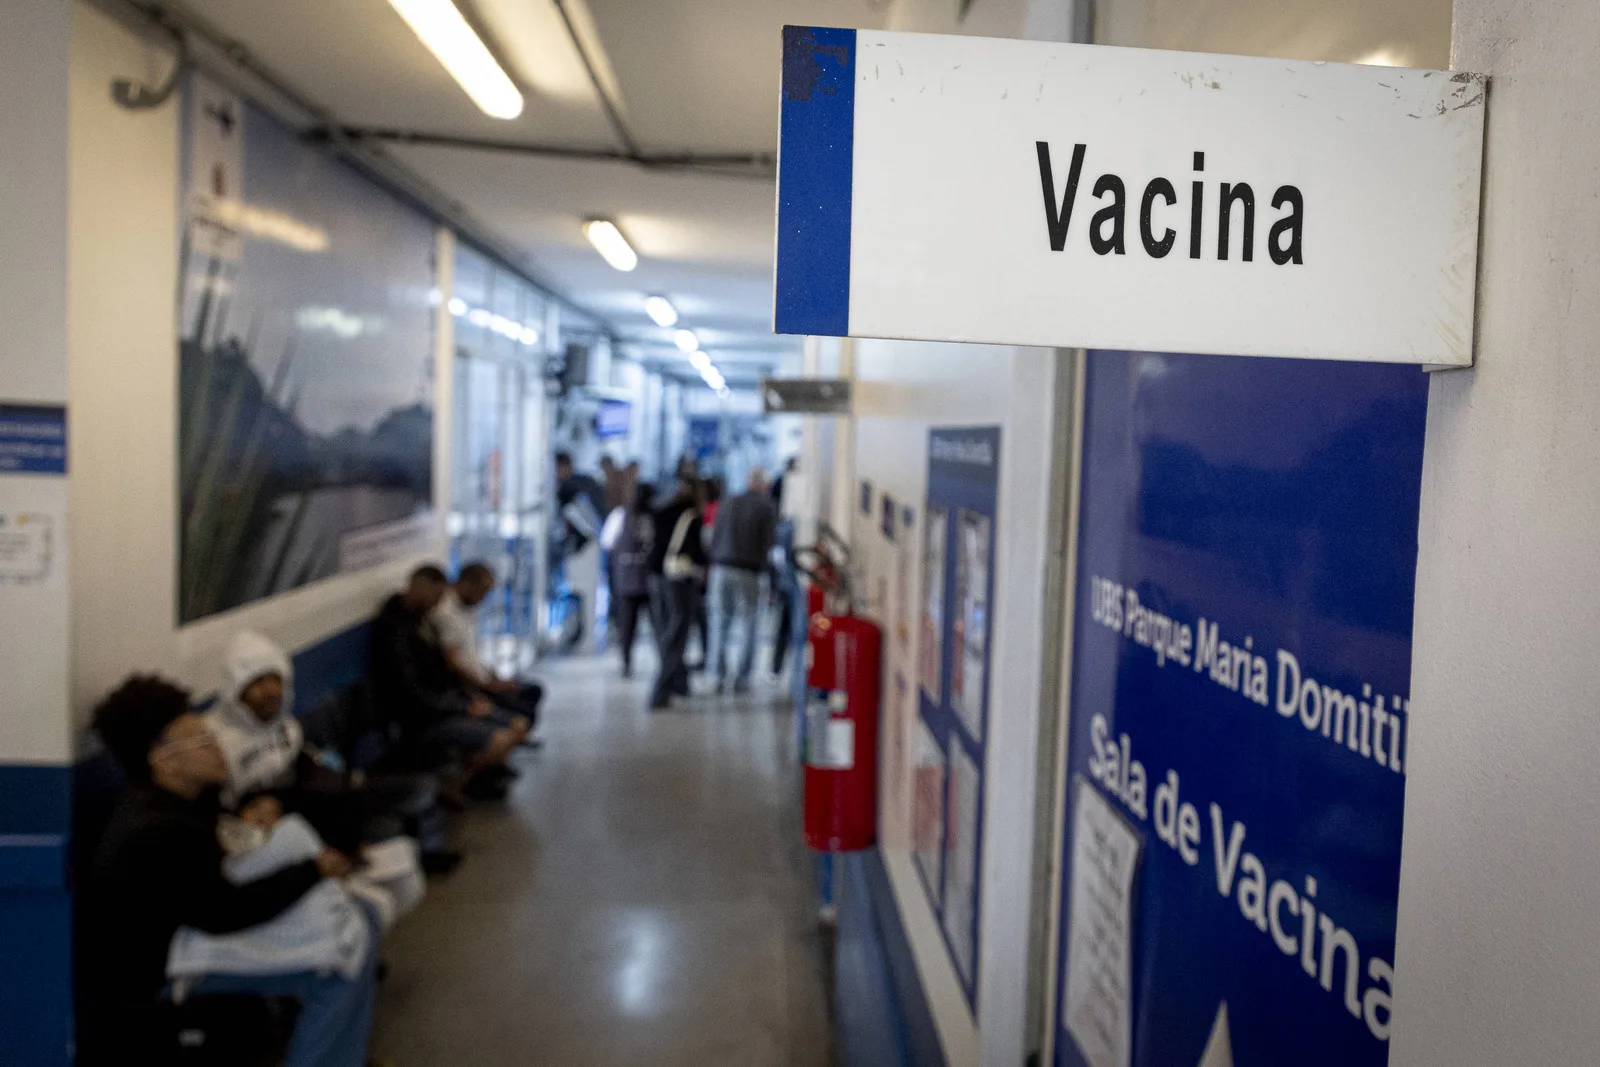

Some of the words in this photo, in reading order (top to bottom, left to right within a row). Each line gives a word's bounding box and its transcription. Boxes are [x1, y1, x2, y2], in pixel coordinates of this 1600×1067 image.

[1035, 141, 1304, 265] Vacina
[1091, 575, 1123, 632] UBS
[1124, 588, 1193, 668] Parque
[1194, 617, 1269, 706] Maria
[1089, 713, 1147, 820] Sala
[1153, 769, 1200, 866] de
[1210, 803, 1394, 1041] Vacina
